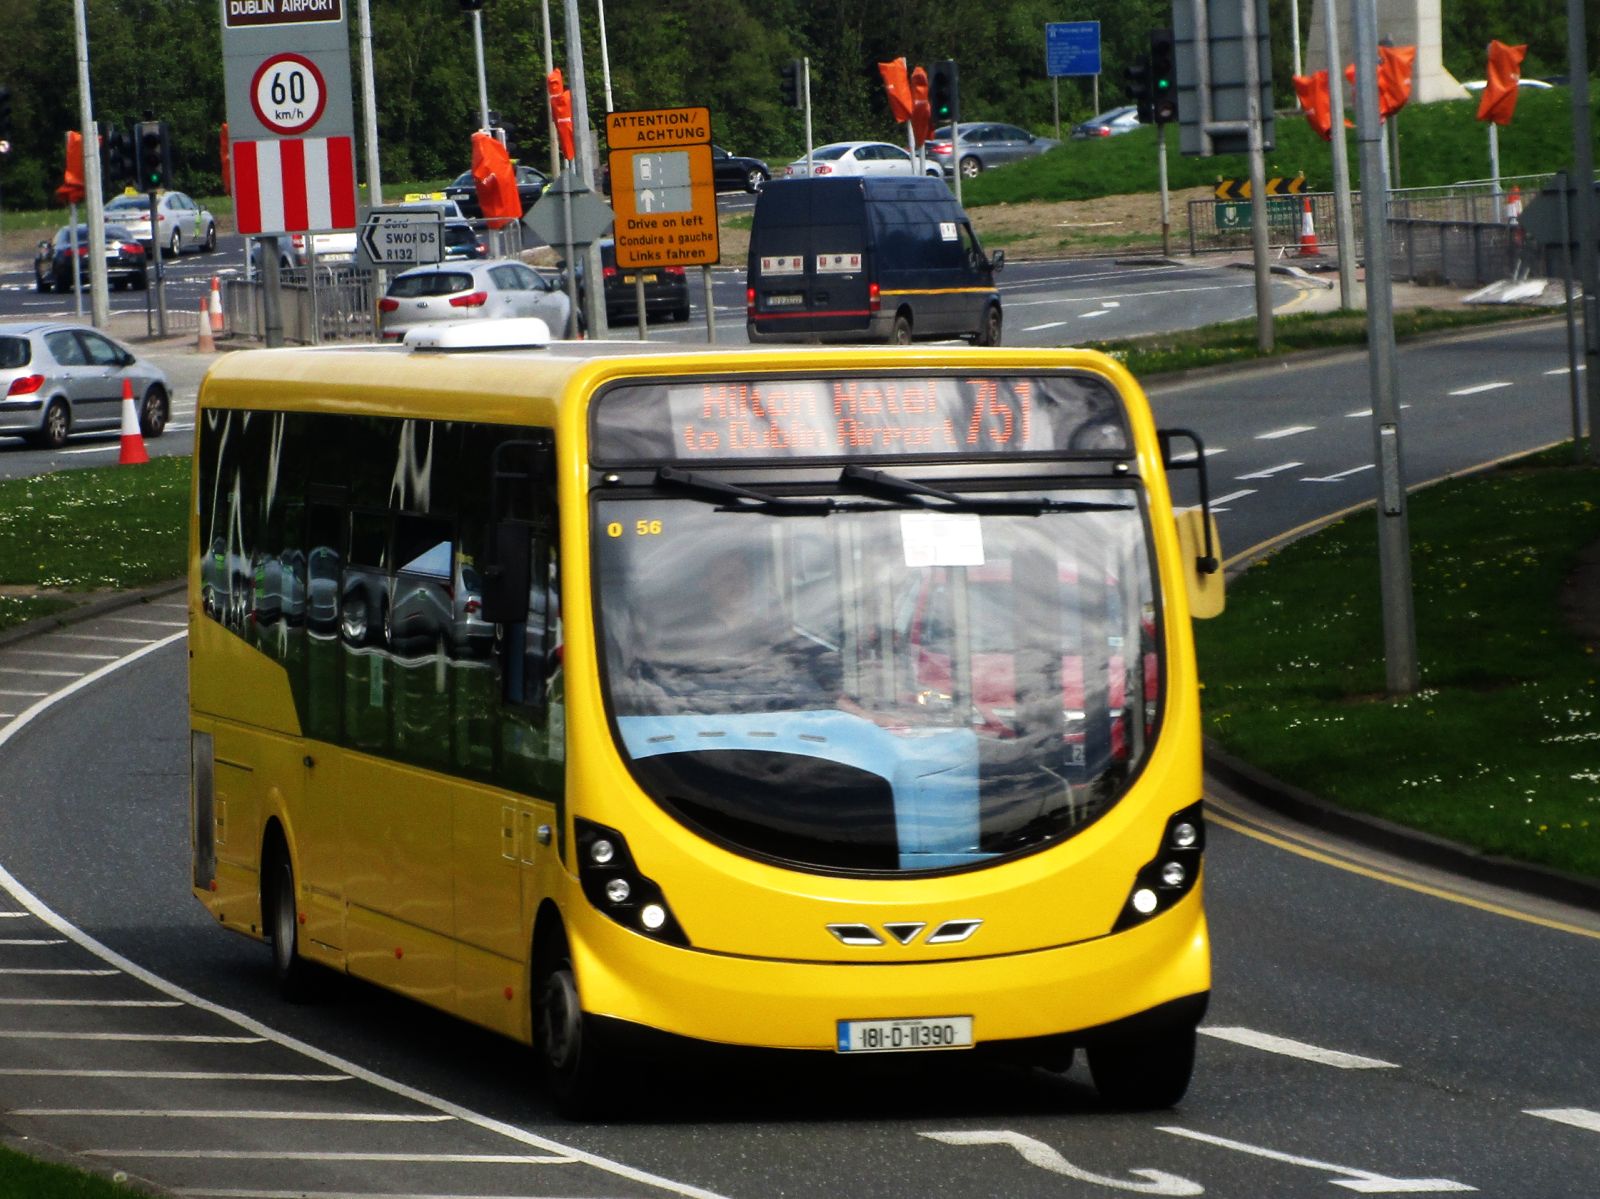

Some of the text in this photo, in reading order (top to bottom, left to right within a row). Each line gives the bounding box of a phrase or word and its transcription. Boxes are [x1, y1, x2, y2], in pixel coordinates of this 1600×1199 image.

[230, 0, 333, 15] DUBLIN AIRPORT
[271, 71, 305, 105] 60
[275, 108, 304, 119] km/h
[637, 127, 705, 141] ACHTUNG
[628, 215, 703, 229] Drive on left
[619, 234, 664, 246] Conduire
[678, 232, 713, 245] gauche
[387, 249, 413, 260] R132
[629, 249, 705, 262] Links fahren
[703, 381, 937, 418] Hilton Hotel
[966, 378, 1032, 445] 751
[683, 417, 957, 451] to Dublin Airport
[636, 520, 662, 536] 56
[862, 1024, 954, 1048] 181-D-11390
